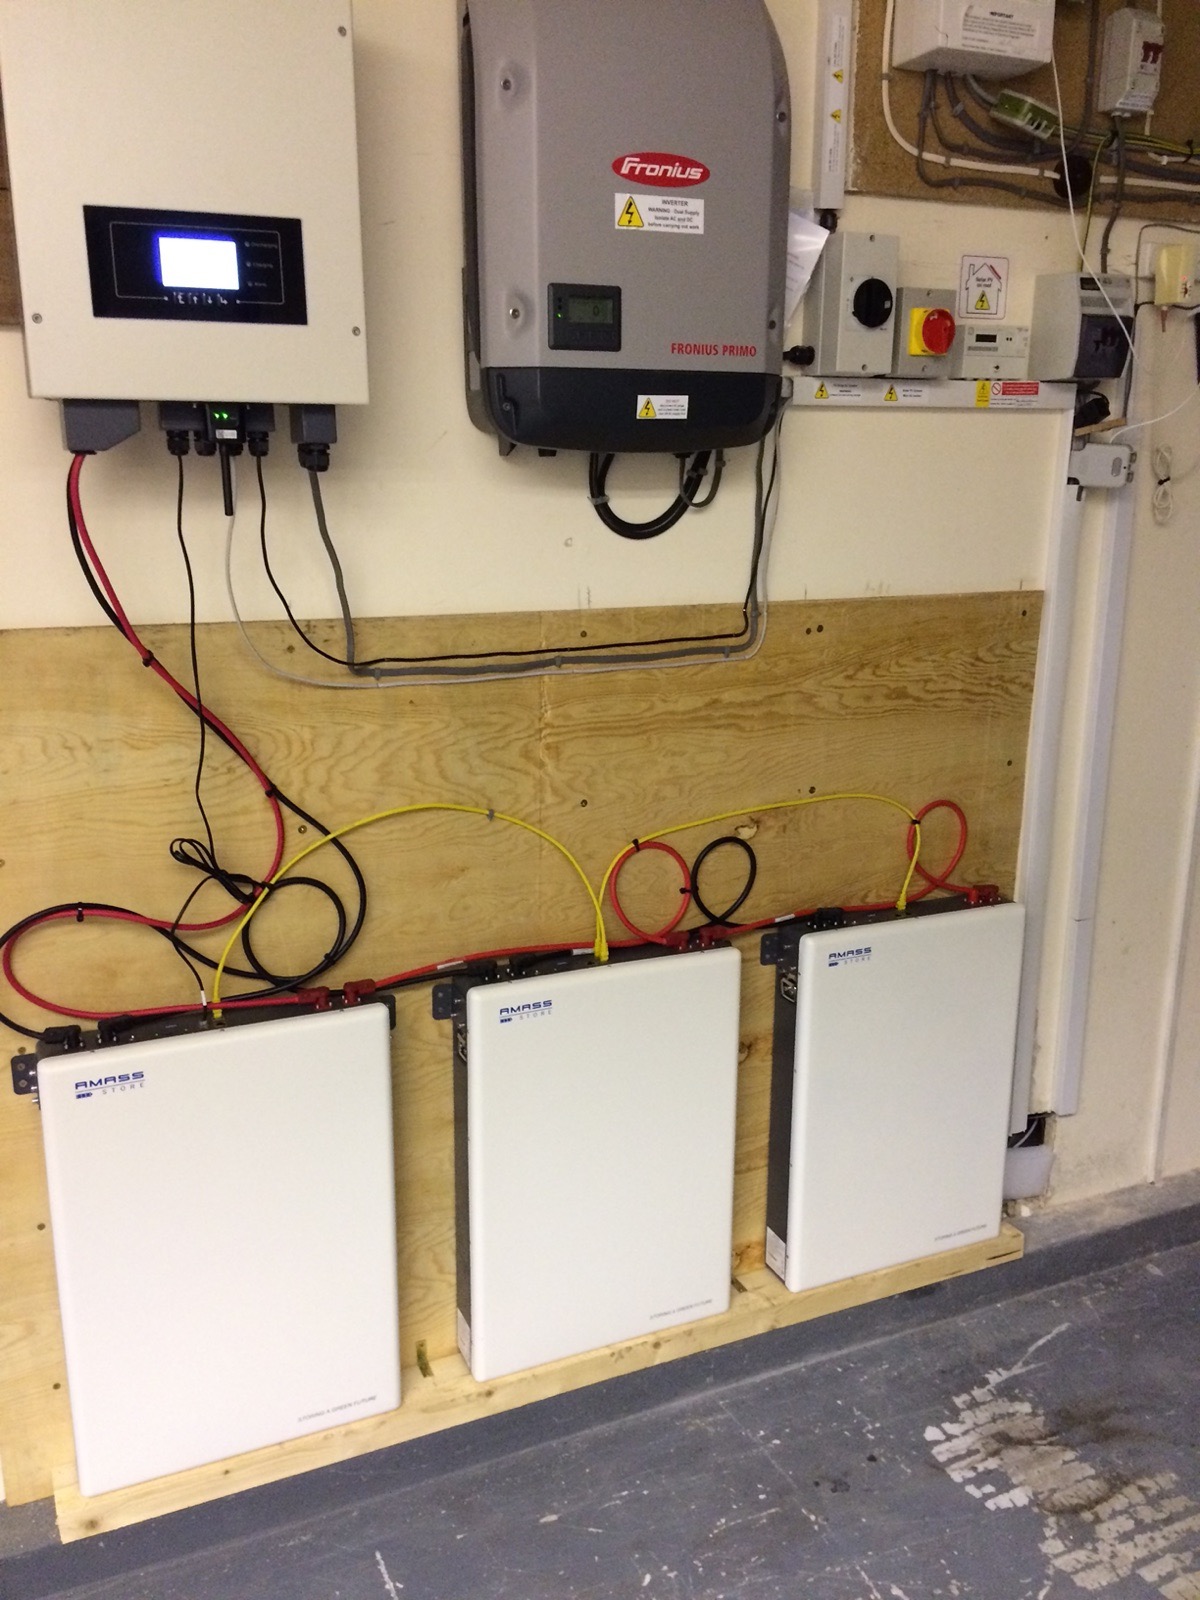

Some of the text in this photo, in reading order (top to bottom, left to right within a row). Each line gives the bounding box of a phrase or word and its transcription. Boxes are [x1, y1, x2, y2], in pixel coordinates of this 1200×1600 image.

[620, 156, 704, 180] Fronius
[671, 342, 757, 357] FRONIUS PRIMO
[828, 946, 872, 959] AMASS
[499, 999, 553, 1015] AMASS
[519, 1010, 552, 1020] STORE
[75, 1071, 145, 1090] AMASS
[102, 1082, 145, 1095] STORE
